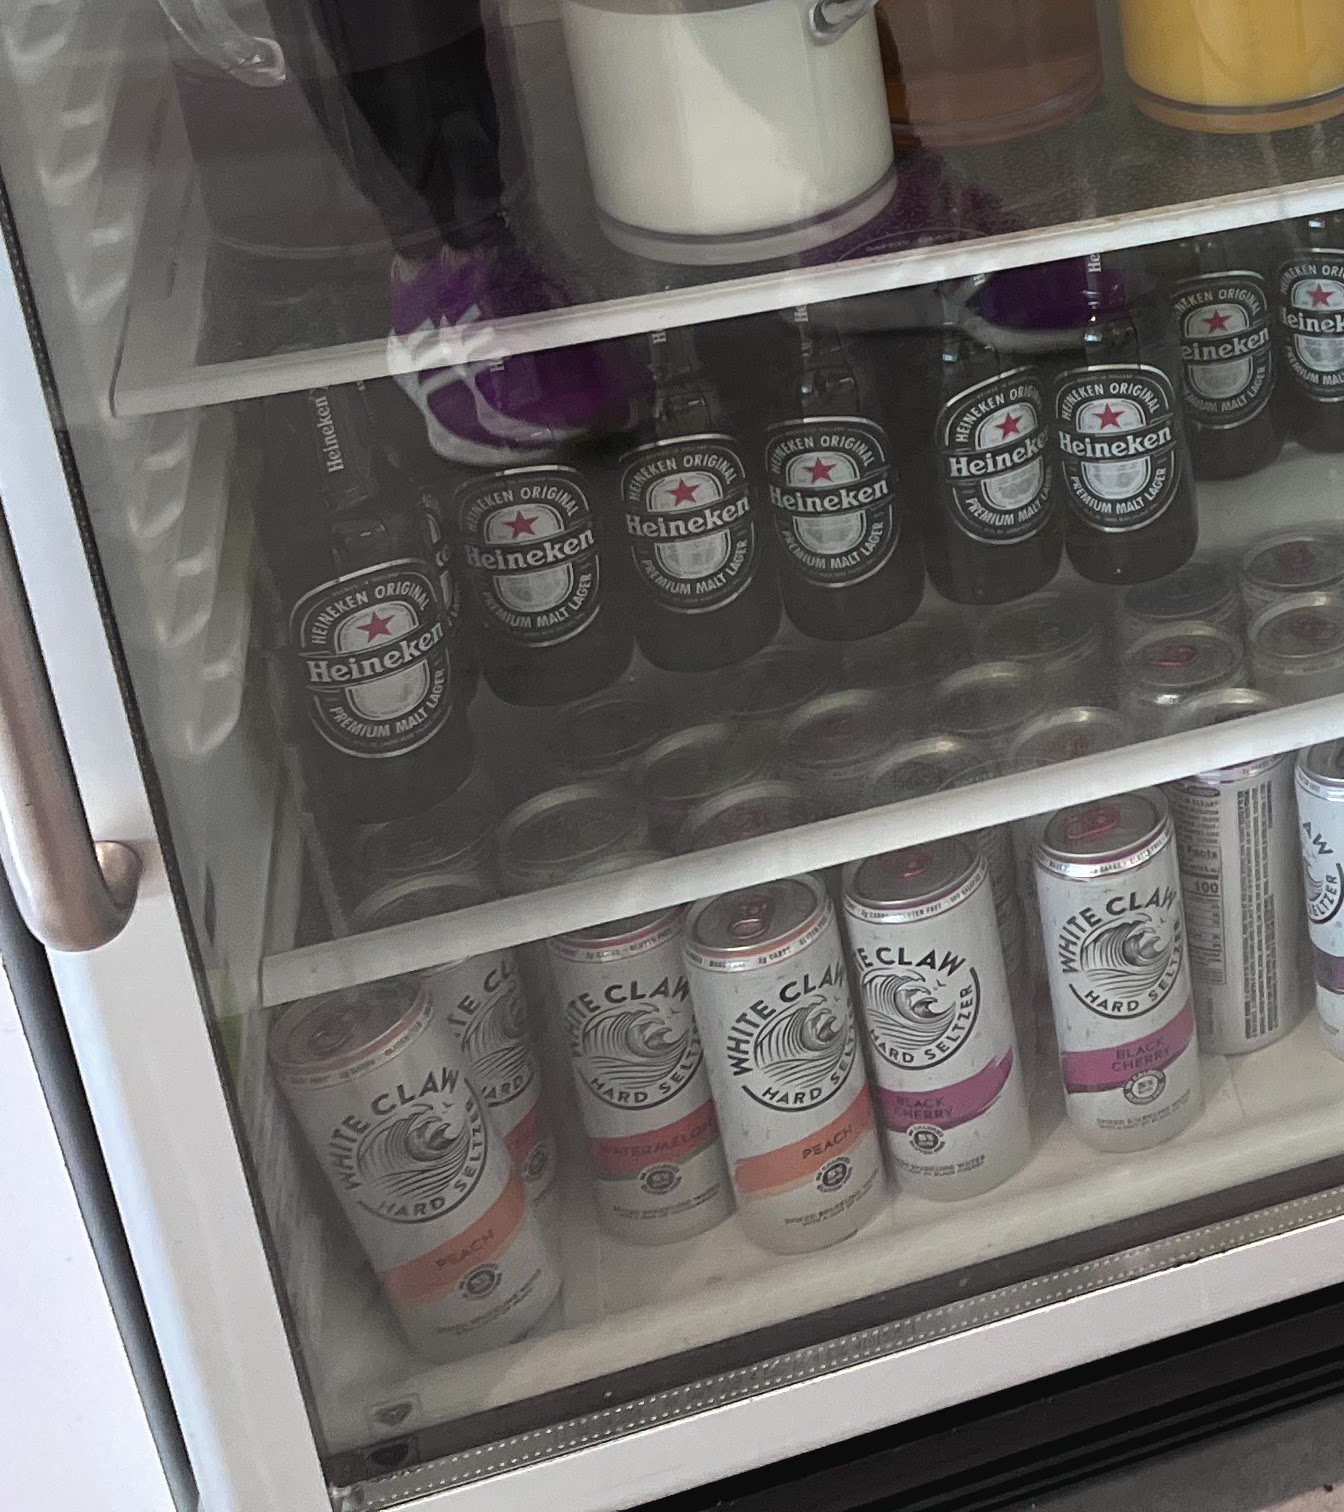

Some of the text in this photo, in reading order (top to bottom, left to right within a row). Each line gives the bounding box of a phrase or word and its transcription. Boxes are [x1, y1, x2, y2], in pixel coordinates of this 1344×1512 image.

[1218, 288, 1261, 316] ORIGINAL
[955, 392, 1005, 443] HEINEKEN
[1061, 382, 1161, 421] HEINEKEN ORIGINAL
[1221, 395, 1247, 412] MALT
[314, 395, 345, 473] Heineken
[771, 435, 876, 474] HEINEKEN ORIGINAL
[949, 431, 1046, 477] Heineke
[1058, 427, 1172, 458] Heineken
[629, 453, 738, 502] HEINEKEN ORIGINAL
[769, 480, 889, 512] Heineken
[1071, 467, 1167, 515] PREMIUM MALT LAGER
[466, 485, 579, 532] HEINEKEN ORIGINAL
[625, 496, 750, 537] Heineken
[965, 497, 1041, 526] PREMIUM MALT
[464, 529, 595, 570] Heineken
[830, 521, 883, 569] MALT LAGER
[642, 539, 748, 595] PREMIUM MALT LAGER
[311, 580, 431, 646] HEINEKEN ORIGINAL
[536, 608, 569, 627] MALT
[568, 573, 592, 611] LAGER
[306, 621, 445, 683] Heineken
[329, 668, 446, 739] PREMIUM MALT LAGER
[1058, 886, 1178, 974] WHITE CLAW
[875, 946, 966, 977] CLAW
[603, 976, 690, 1004] CLAW
[1083, 989, 1140, 1014] HARD
[726, 999, 777, 1077] WHITE
[923, 984, 973, 1061] SELTZER
[1111, 1048, 1171, 1072] CHERRY
[1115, 1039, 1166, 1060] BLACK
[589, 1077, 649, 1104] HARD
[761, 1086, 823, 1106] HARD
[328, 1066, 460, 1191] WHITE CLAW
[893, 1106, 953, 1122] CHERRY
[802, 1125, 854, 1160] PEACH
[378, 1196, 446, 1217] HARD
[434, 1228, 496, 1270] PEACH
